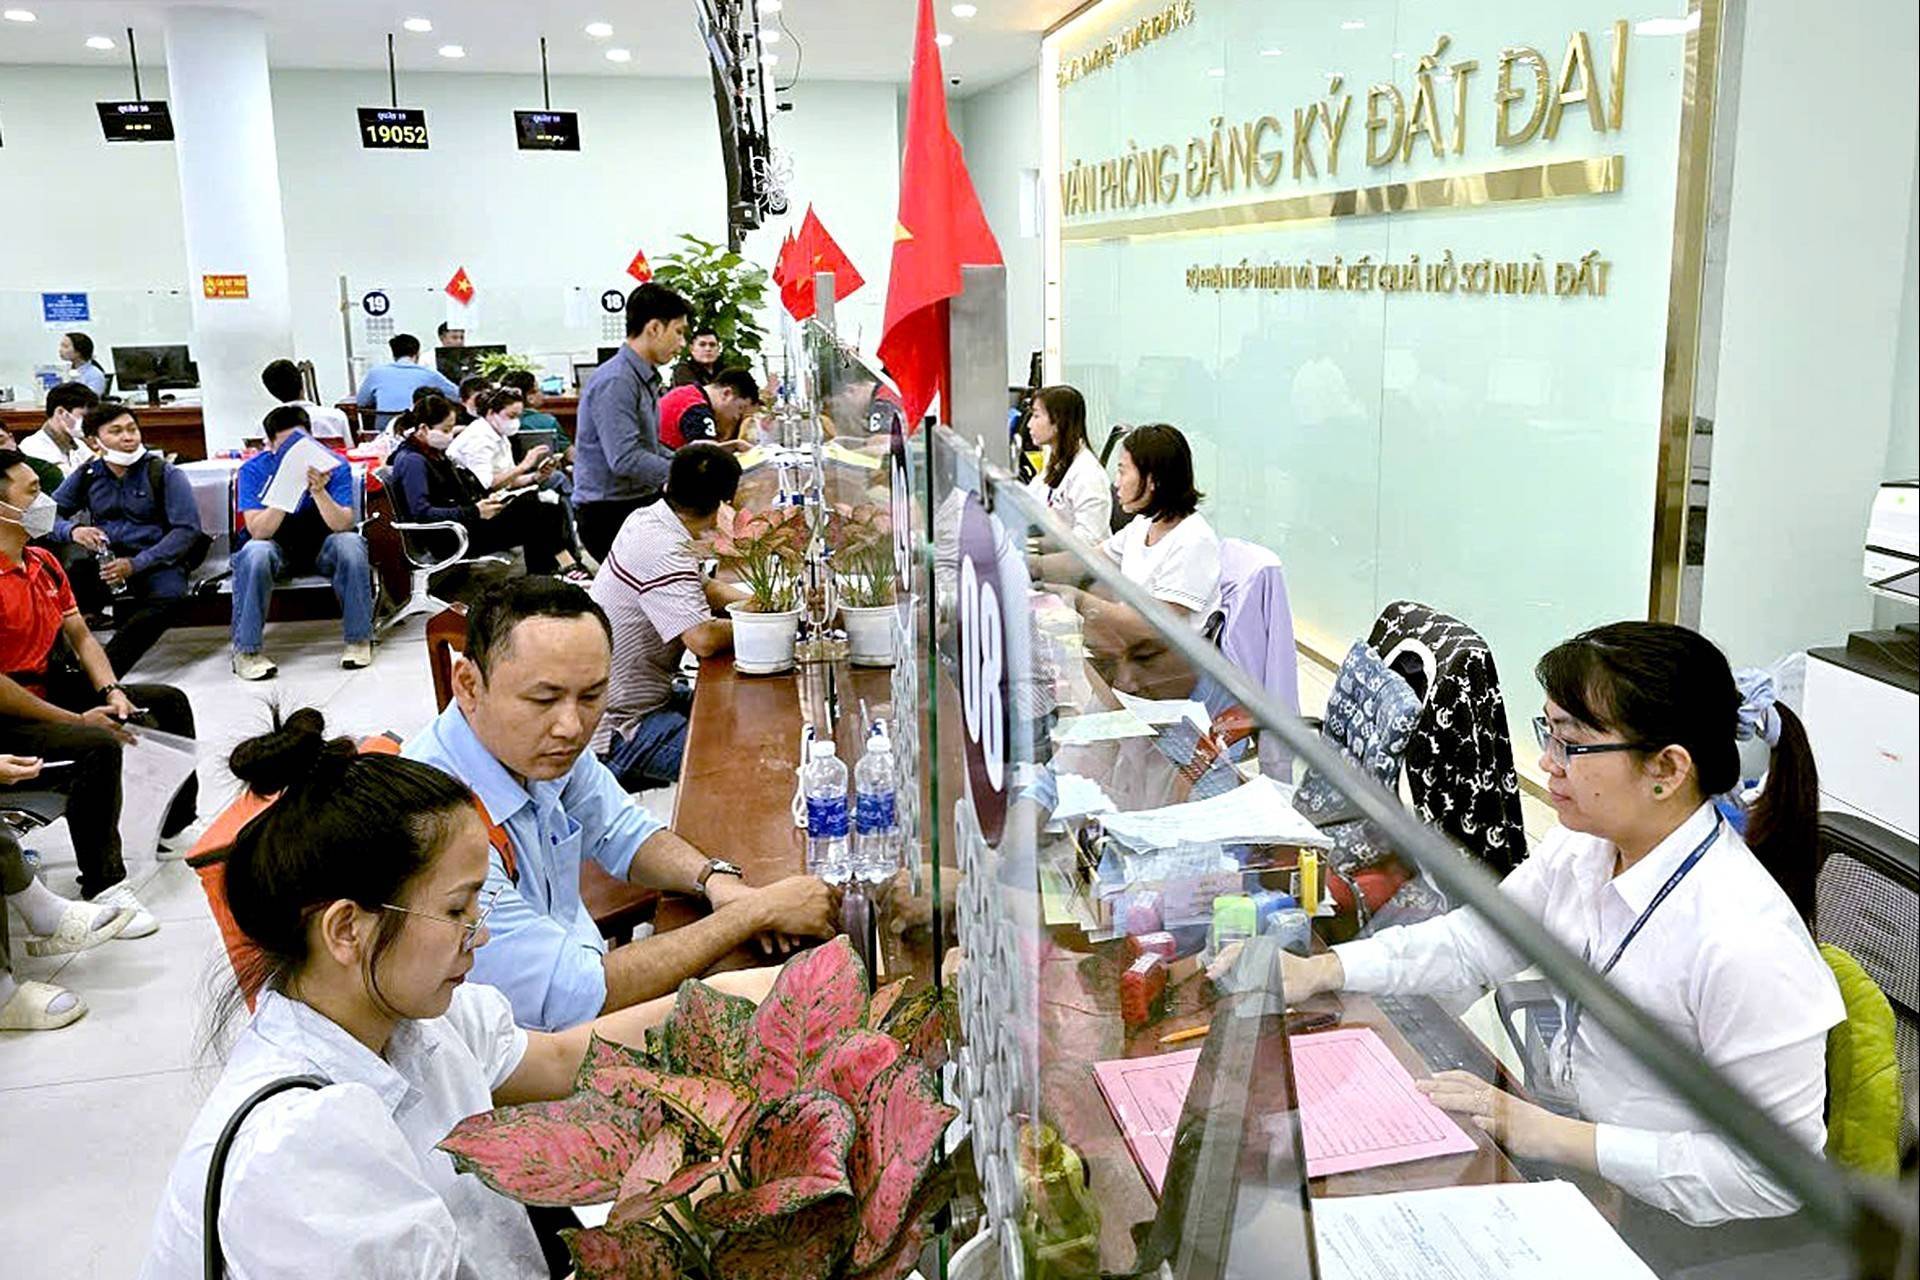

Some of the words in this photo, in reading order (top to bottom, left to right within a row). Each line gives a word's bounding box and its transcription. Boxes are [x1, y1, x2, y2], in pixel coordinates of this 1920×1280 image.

[1101, 140, 1180, 211] PHÒNG
[1186, 117, 1283, 197] ĐĂNG
[1293, 76, 1352, 179] KÝ
[1366, 35, 1478, 166] ĐẤT
[1496, 20, 1628, 147] ĐAI
[367, 125, 426, 143] 19052
[1379, 254, 1423, 293] QUẢ
[1459, 259, 1492, 293] SƠ
[1493, 254, 1549, 294] NHÀ
[1554, 250, 1613, 297] ĐẤT
[366, 296, 386, 312] 19
[604, 294, 622, 309] 18
[703, 417, 717, 436] 3
[961, 554, 1004, 792] 08
